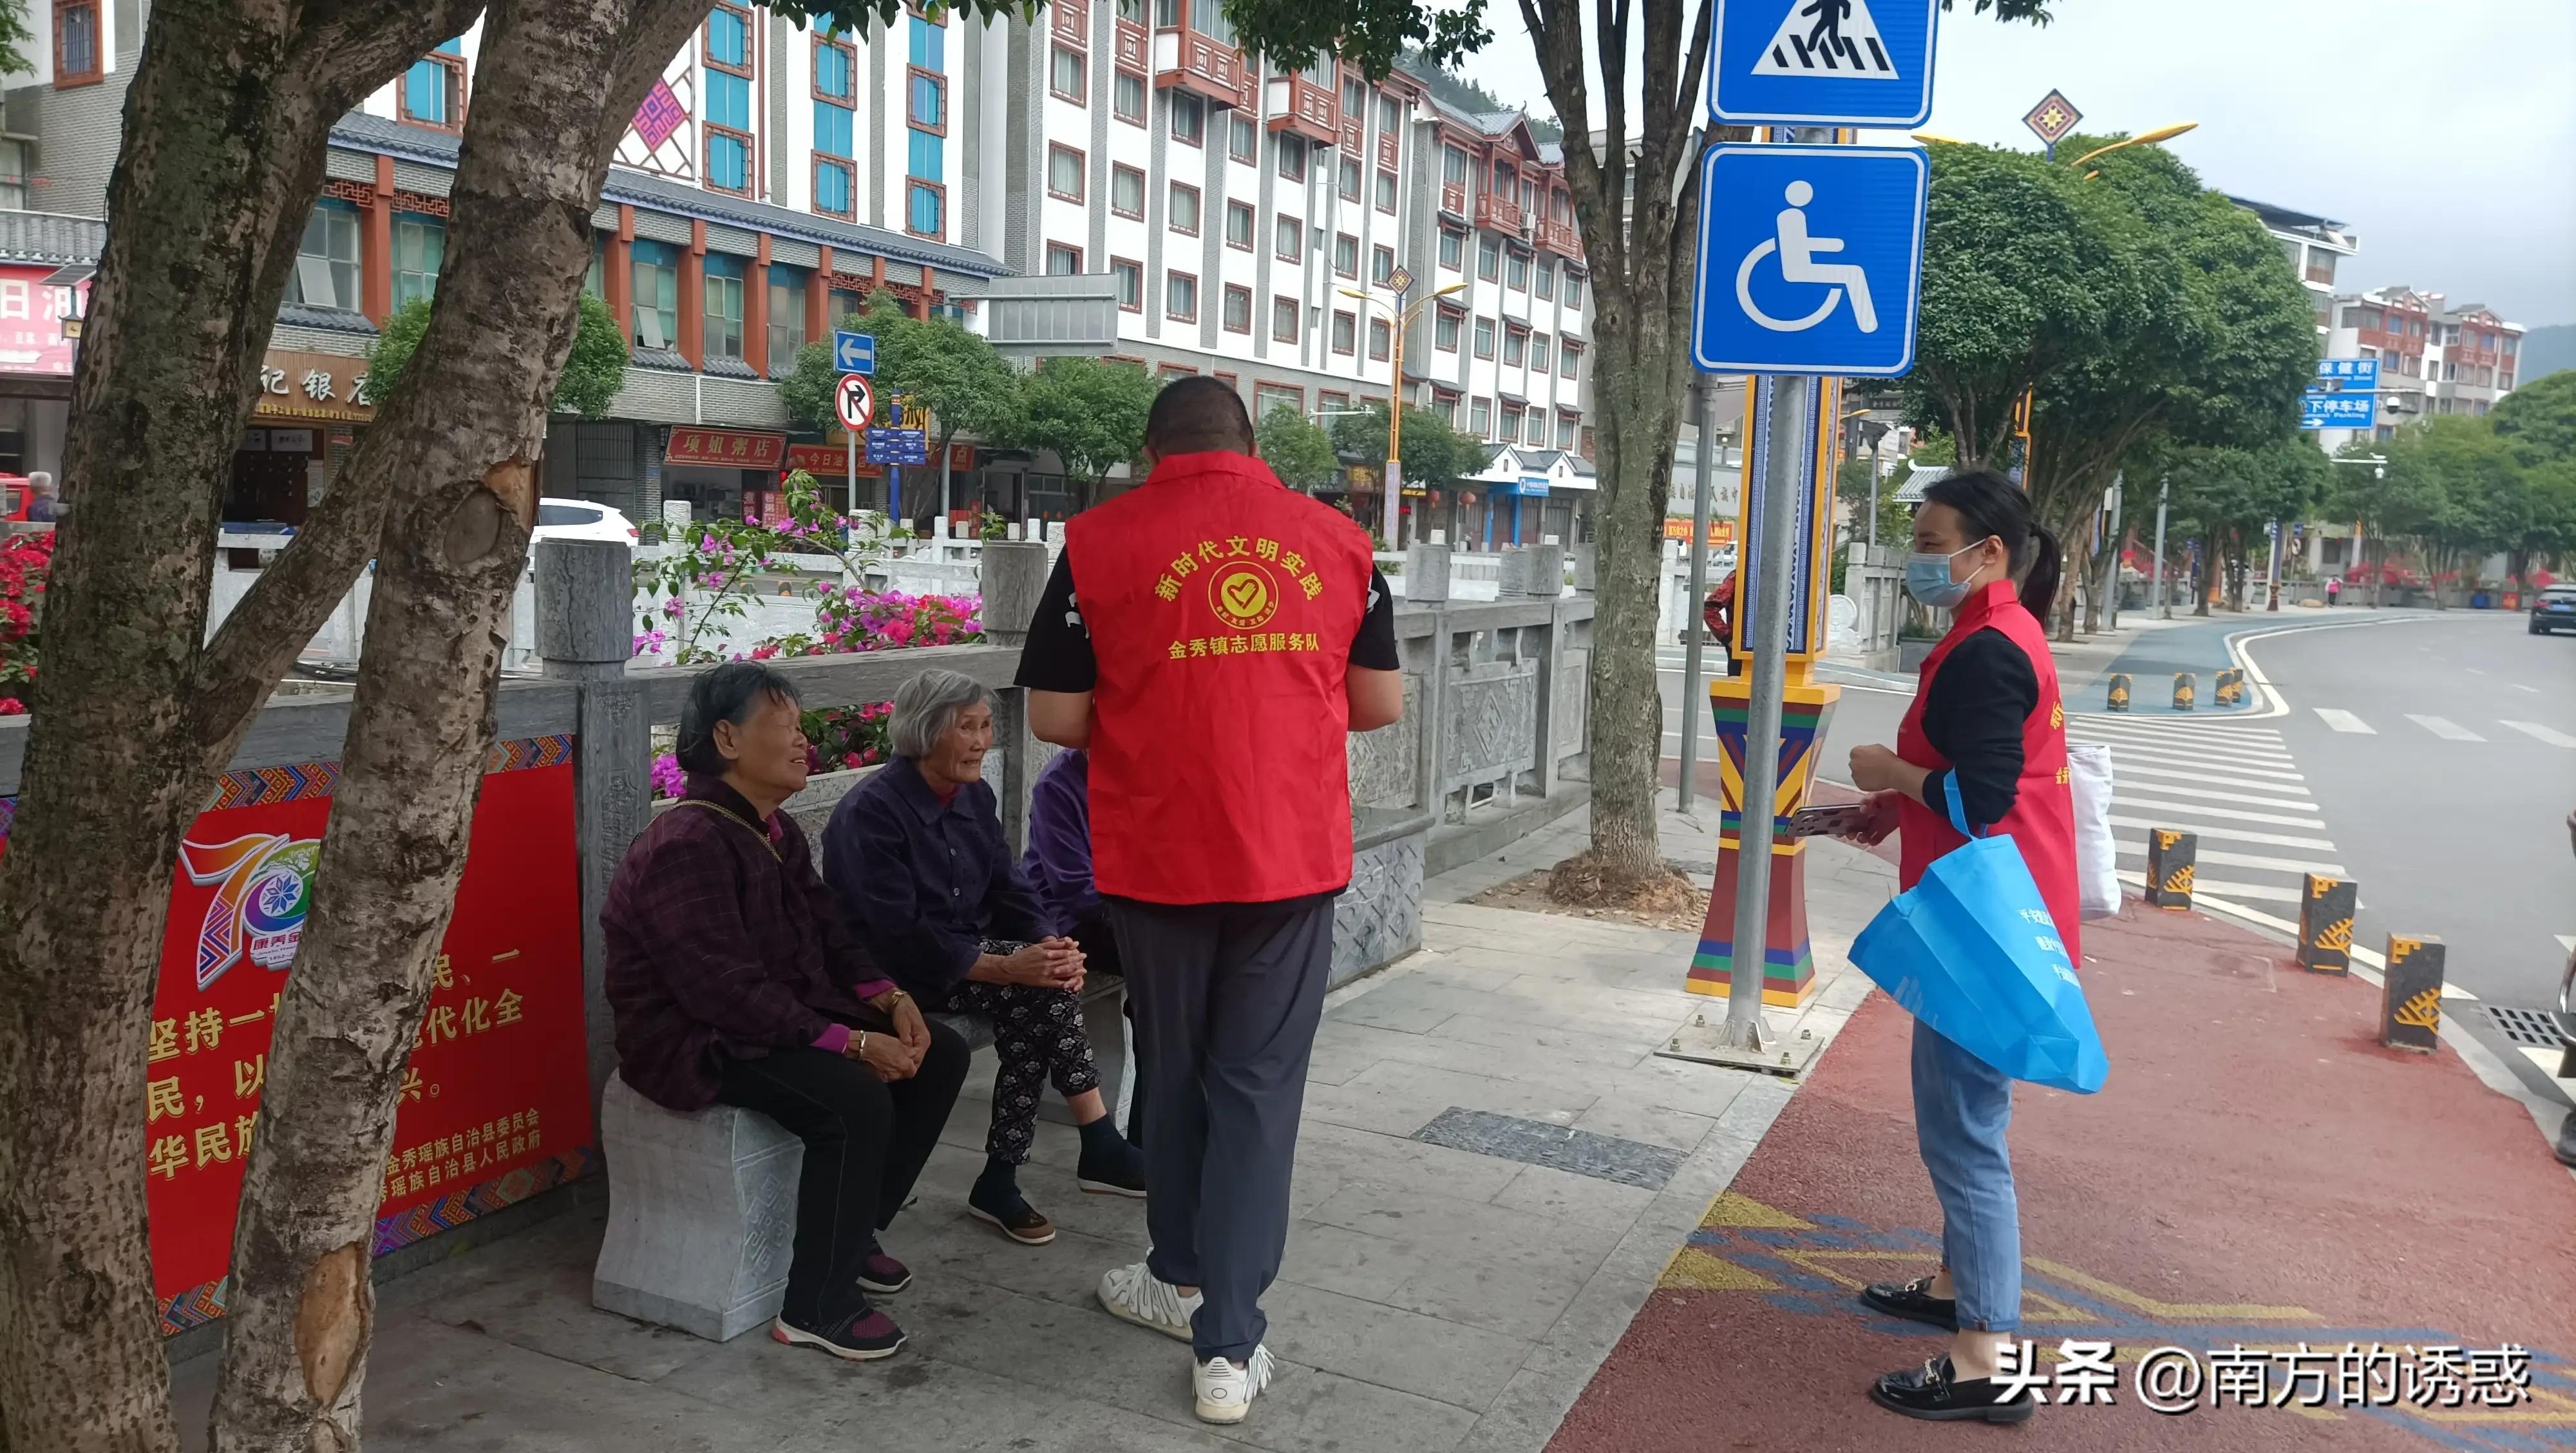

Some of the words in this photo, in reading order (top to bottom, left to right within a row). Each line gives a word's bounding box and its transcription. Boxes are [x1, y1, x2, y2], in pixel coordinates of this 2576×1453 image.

[810, 451, 866, 469] 今日油店
[1155, 535, 1323, 602] 新时代文明实践
[1168, 632, 1320, 660] 金秀镇志愿服务队
[387, 1107, 540, 1175] 金秀瑶族自治县委员会
